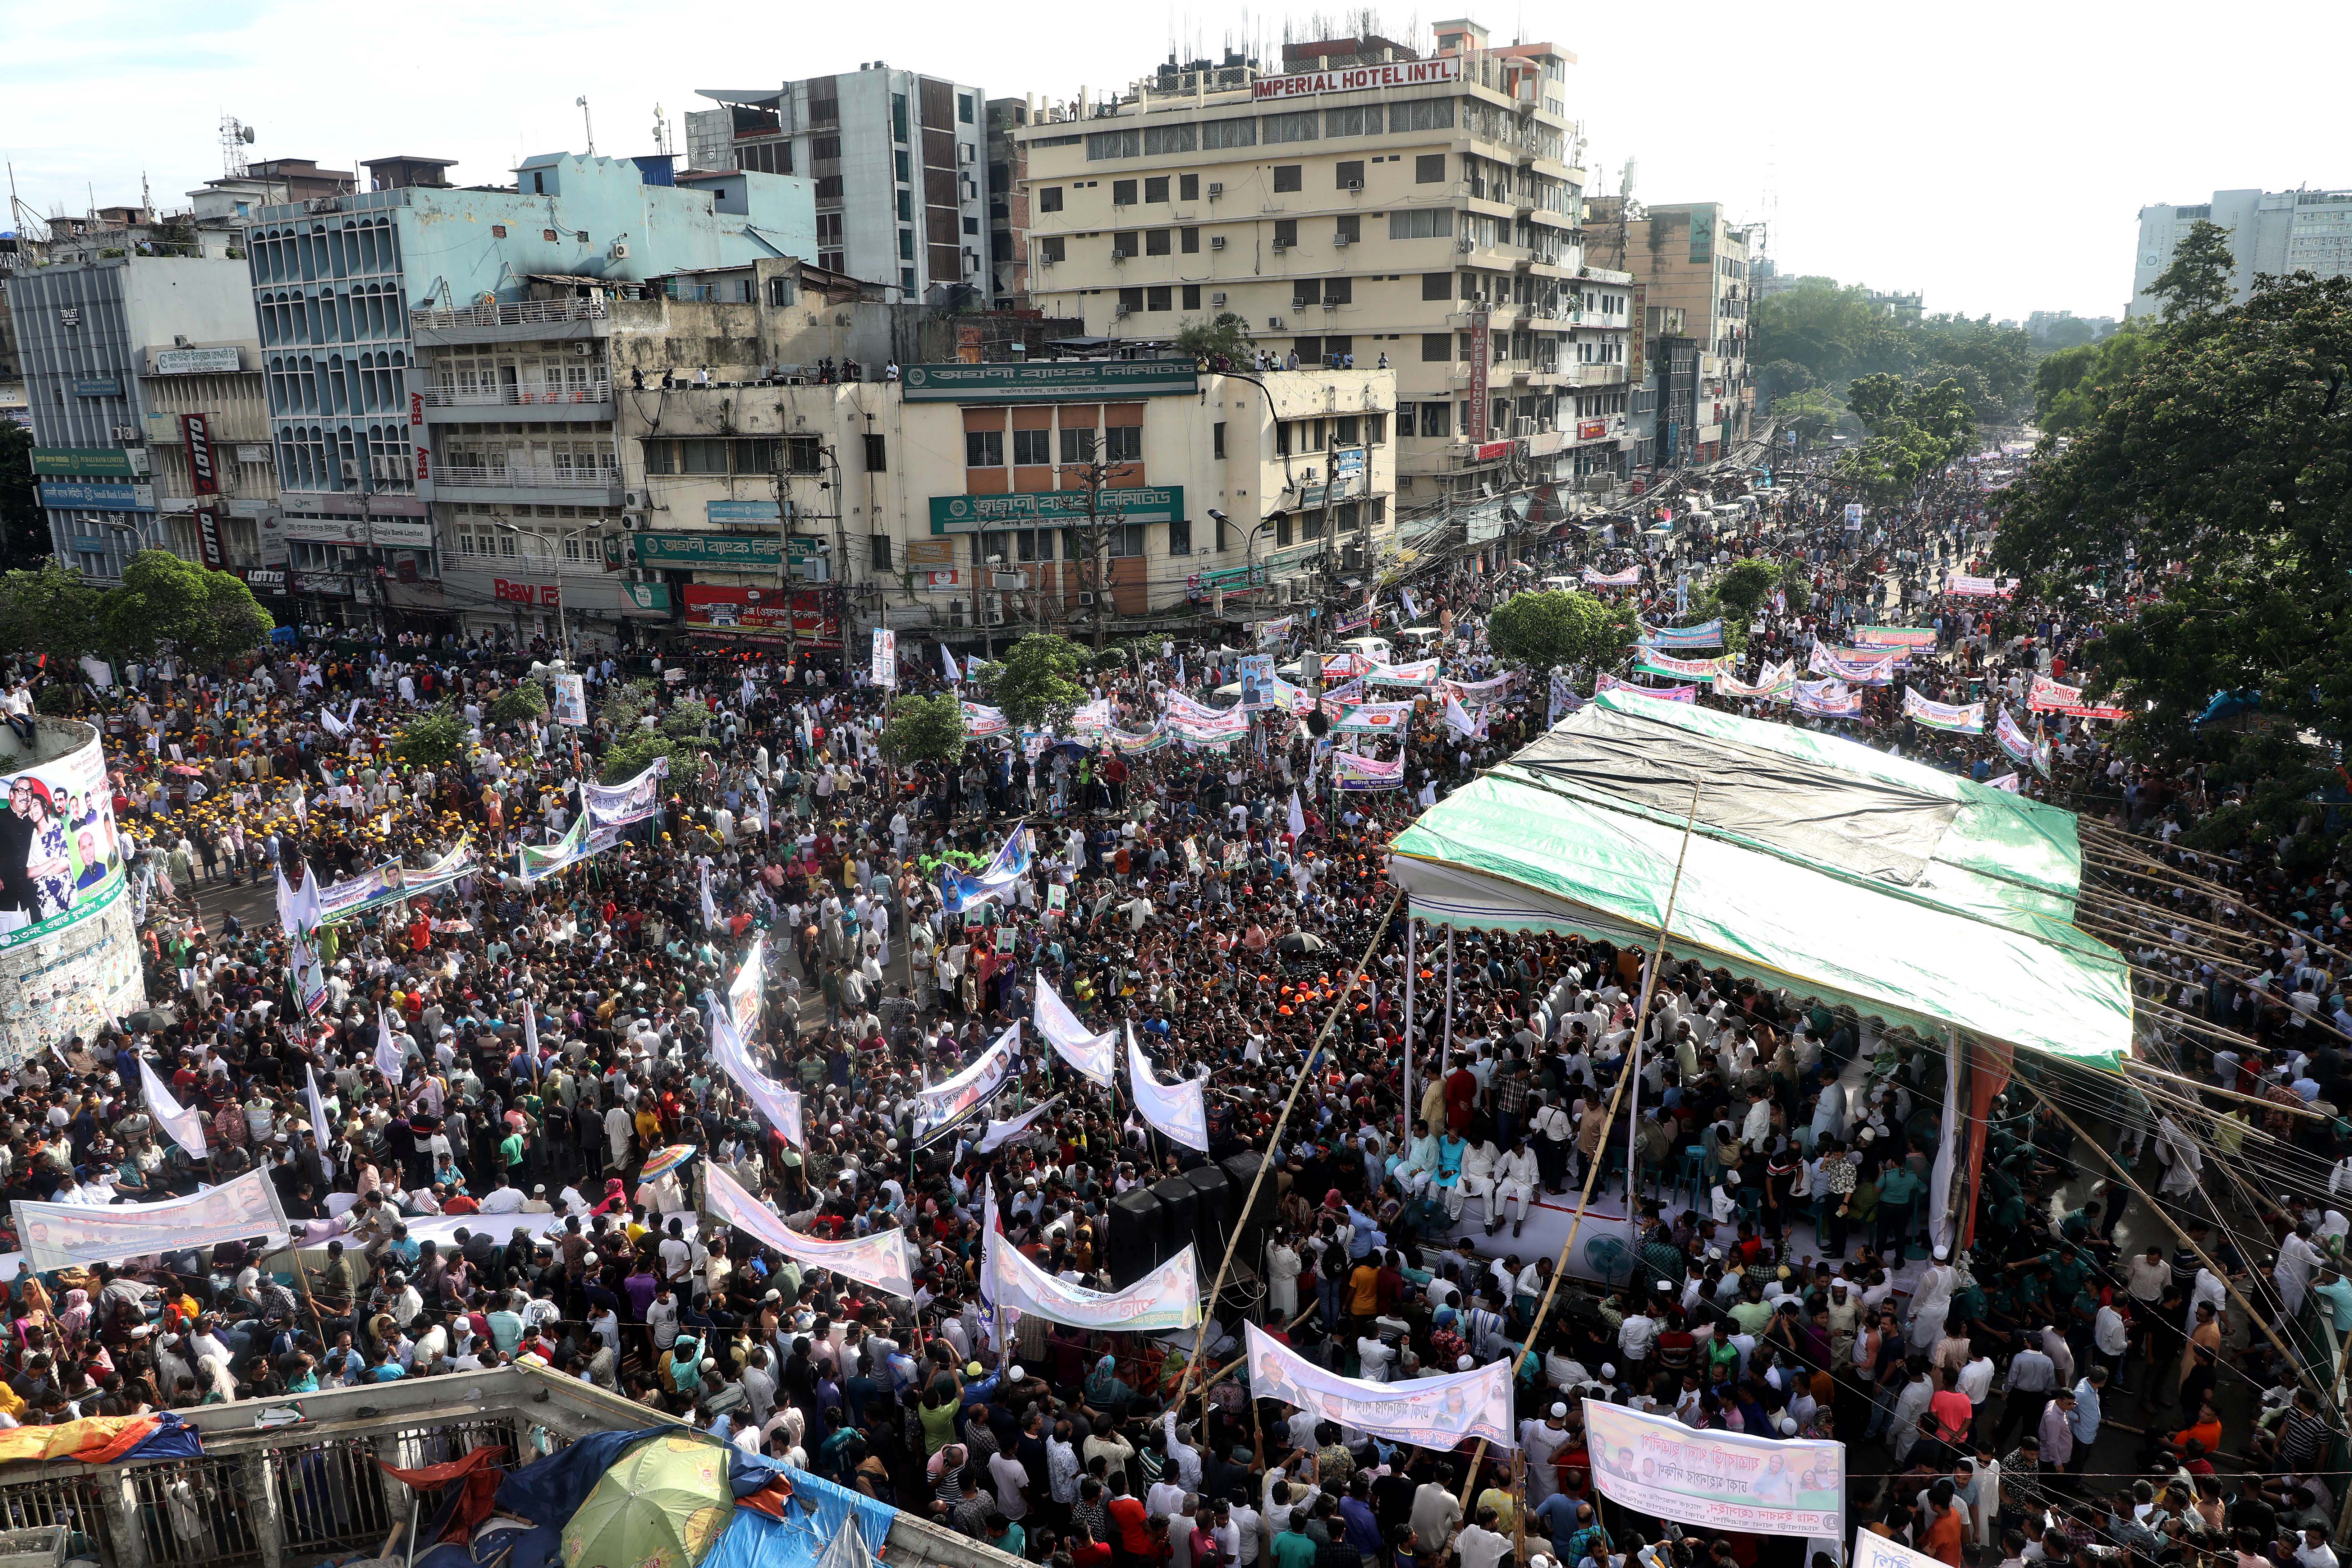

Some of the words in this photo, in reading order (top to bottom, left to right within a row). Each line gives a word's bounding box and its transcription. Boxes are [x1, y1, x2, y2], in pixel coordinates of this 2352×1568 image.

[1254, 74, 1337, 97] IMPERIAL
[1343, 67, 1404, 88] HOTEL
[1408, 61, 1458, 81] INTL.
[60, 308, 78, 318] TO-LET
[1634, 294, 1645, 365] MEGHNA
[931, 367, 1015, 379] অগ্রণী
[1021, 368, 1095, 379] ব্যাংক
[1101, 363, 1195, 376] লিমিটেড
[411, 392, 424, 425] Bay
[189, 418, 211, 477] LOTTO
[417, 446, 430, 480] Bay
[44, 487, 57, 498] সোনালী
[94, 490, 106, 499] Sonali
[107, 491, 118, 499] Bank
[118, 491, 134, 499] Limited
[973, 494, 1035, 512] অগ্রণী
[1100, 489, 1170, 506] লিমিটেড
[108, 515, 125, 524] TO-LET
[200, 513, 220, 564] LOTTO
[661, 537, 705, 553] অগ্রণী
[707, 541, 749, 555] ব্যাংক
[248, 570, 285, 583] LOTTO
[494, 578, 535, 610] Bay
[1691, 626, 1712, 636] আওয়ামী
[1713, 621, 1721, 630] লীগ
[1686, 661, 1705, 673] আওয়ামী
[2054, 687, 2076, 702] শান্তি
[1918, 709, 1930, 718] শান্তি
[1931, 713, 1957, 723] সমাবেশ
[603, 795, 625, 807] সমাবেশ
[327, 900, 341, 908] শান্তি
[342, 892, 365, 904] সমাবেশ
[334, 887, 357, 897] প্রতিবাদের
[13, 926, 42, 943] ১৩নং
[45, 913, 70, 931] ওয়ার্ড
[71, 902, 100, 920] যুবলীগ,
[944, 1095, 954, 1108] ঢাকা
[953, 1084, 970, 1102] মহানগর
[969, 1072, 985, 1090] দক্ষিণ
[923, 1123, 948, 1141] আনোয়ার
[948, 1113, 965, 1127] হোসেন
